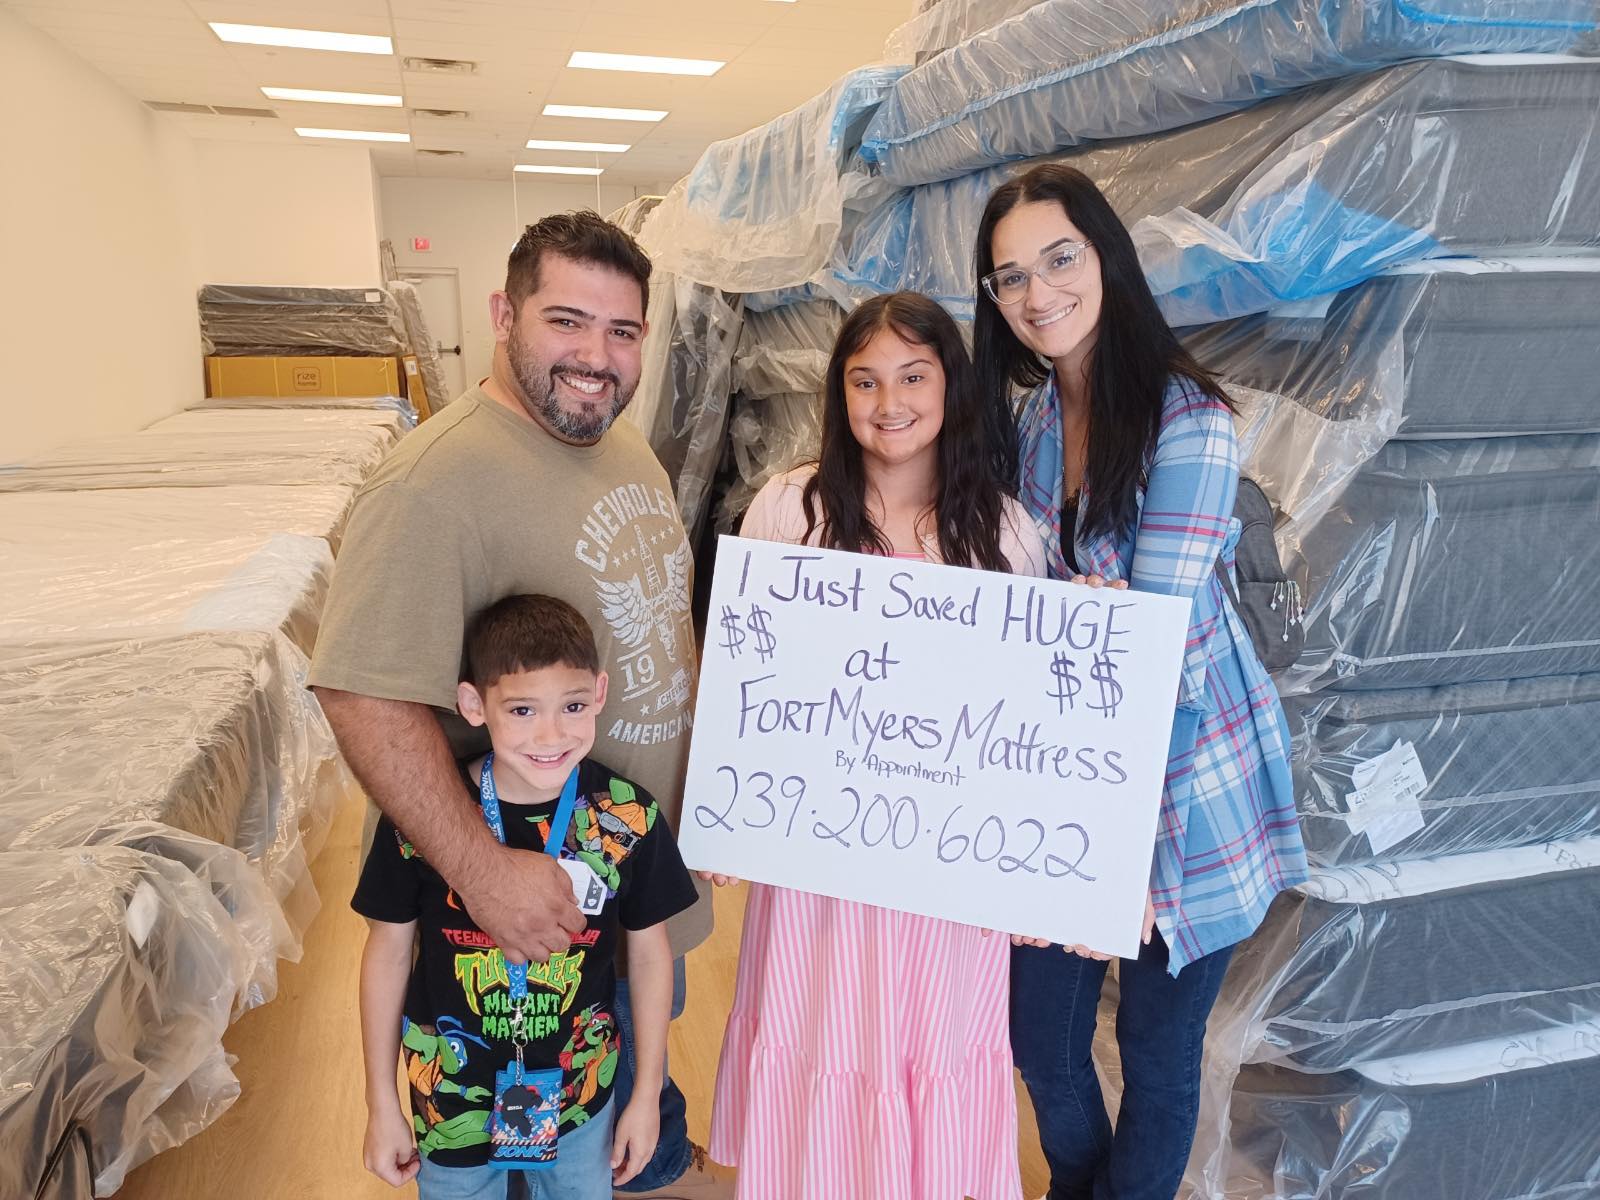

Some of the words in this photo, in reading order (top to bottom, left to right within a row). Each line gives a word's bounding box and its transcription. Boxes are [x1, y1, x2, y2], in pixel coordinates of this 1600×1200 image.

[737, 550, 752, 597] I
[768, 555, 866, 612] Just
[881, 572, 981, 628] Saved
[1001, 583, 1138, 656] HUGE
[622, 654, 656, 693] 19
[844, 641, 901, 682] at
[943, 698, 1128, 785] Mattress
[835, 749, 857, 775] By
[863, 753, 967, 788] Appointment
[494, 1145, 548, 1157] SONIC
